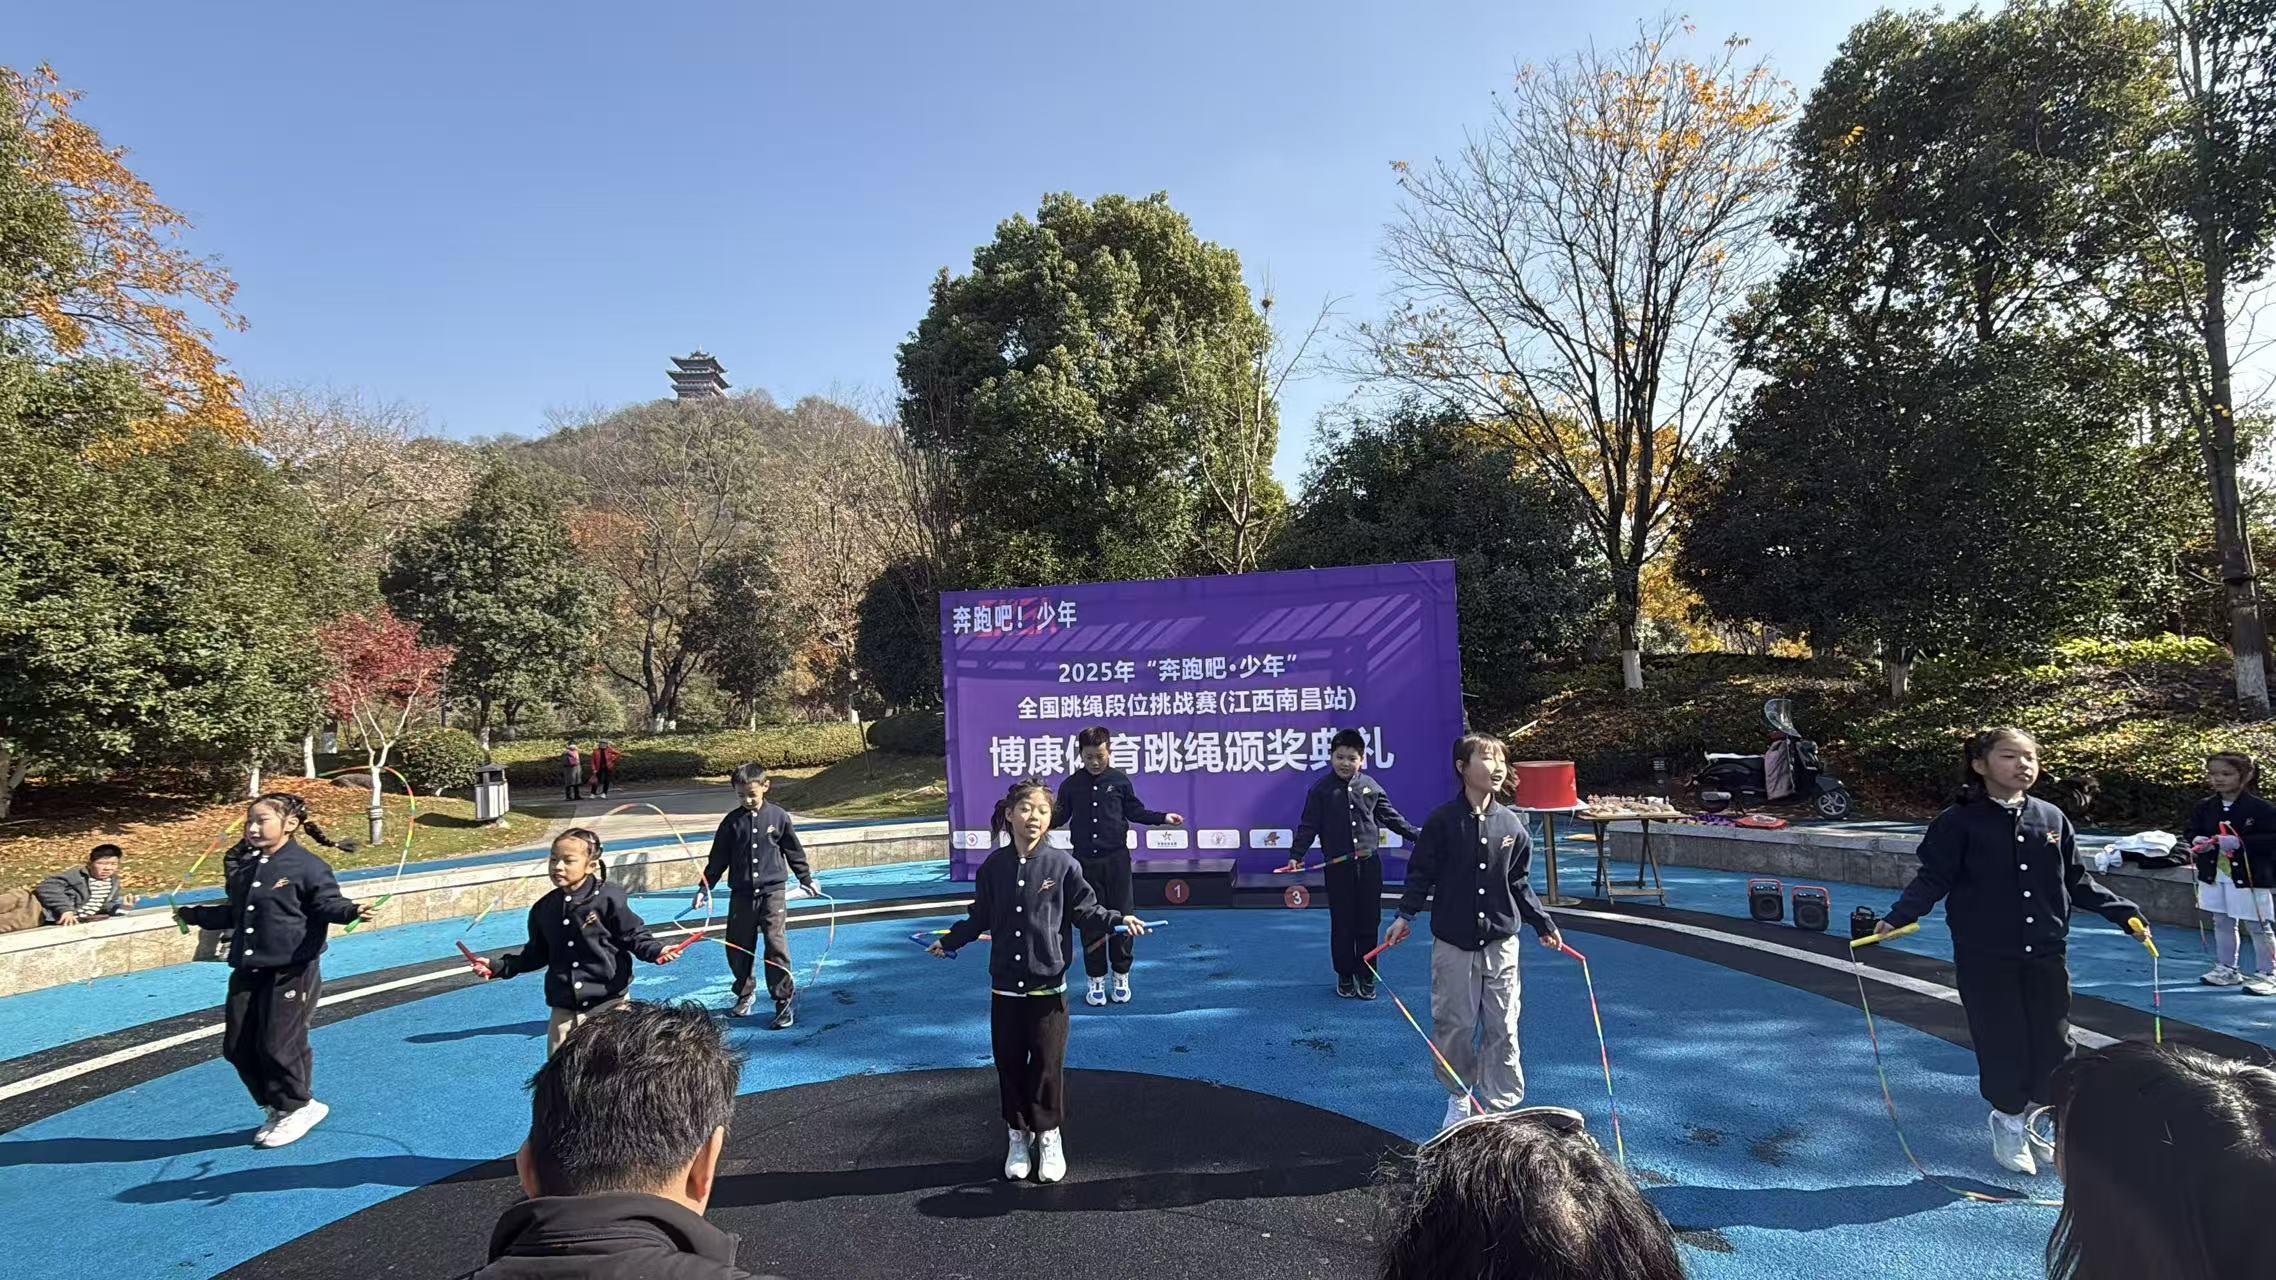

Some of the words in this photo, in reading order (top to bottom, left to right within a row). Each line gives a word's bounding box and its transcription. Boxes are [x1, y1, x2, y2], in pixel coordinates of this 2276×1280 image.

[953, 600, 1077, 634] 奔跑吧！少年
[1018, 685, 1357, 719] 全国跳绳段位挑战赛(江西南昌站)
[1173, 884, 1182, 899] 1
[1292, 890, 1303, 905] 3
